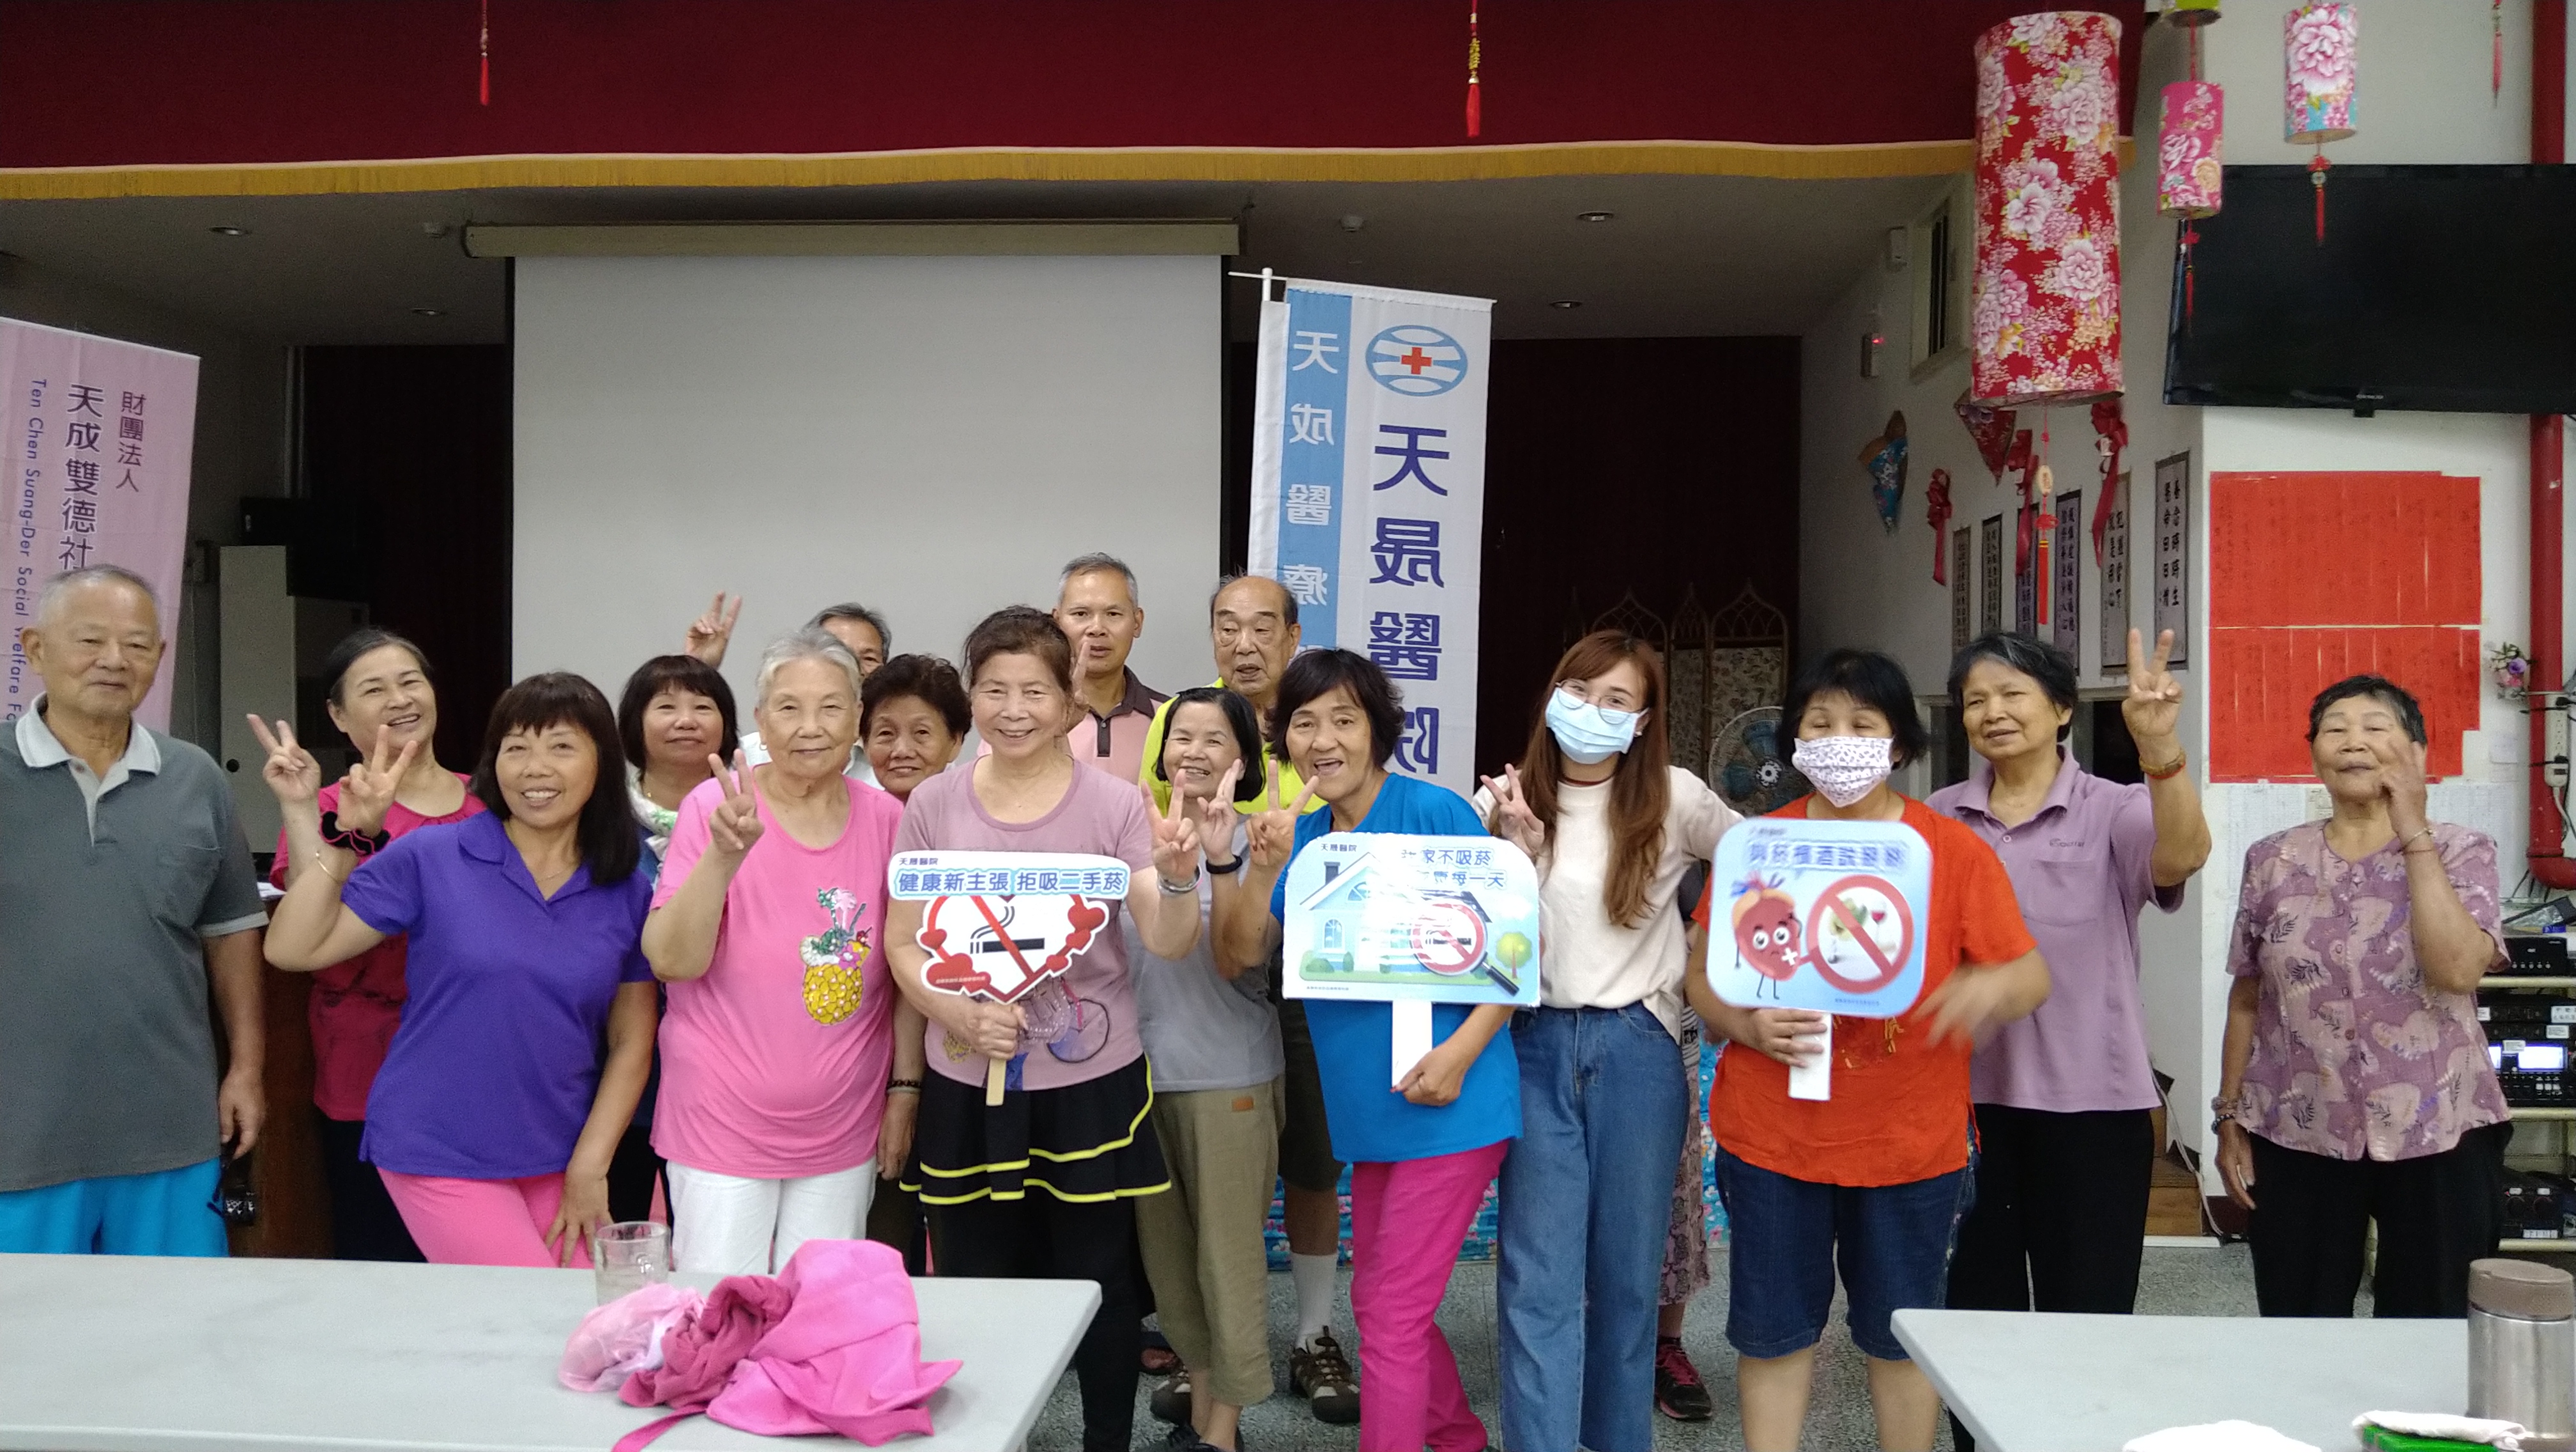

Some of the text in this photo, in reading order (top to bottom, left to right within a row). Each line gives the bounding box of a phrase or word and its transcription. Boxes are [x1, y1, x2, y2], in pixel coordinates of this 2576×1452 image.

[31, 379, 47, 408] Ten
[27, 417, 43, 460] Chen
[116, 391, 146, 492] 財團法人
[59, 384, 103, 569] 天成雙德社
[19, 468, 40, 556] Suang-Der
[15, 566, 32, 616] Social
[1401, 849, 1492, 866] 家不吸菸
[898, 872, 1124, 892] 健康新主張 拒吸二手菸
